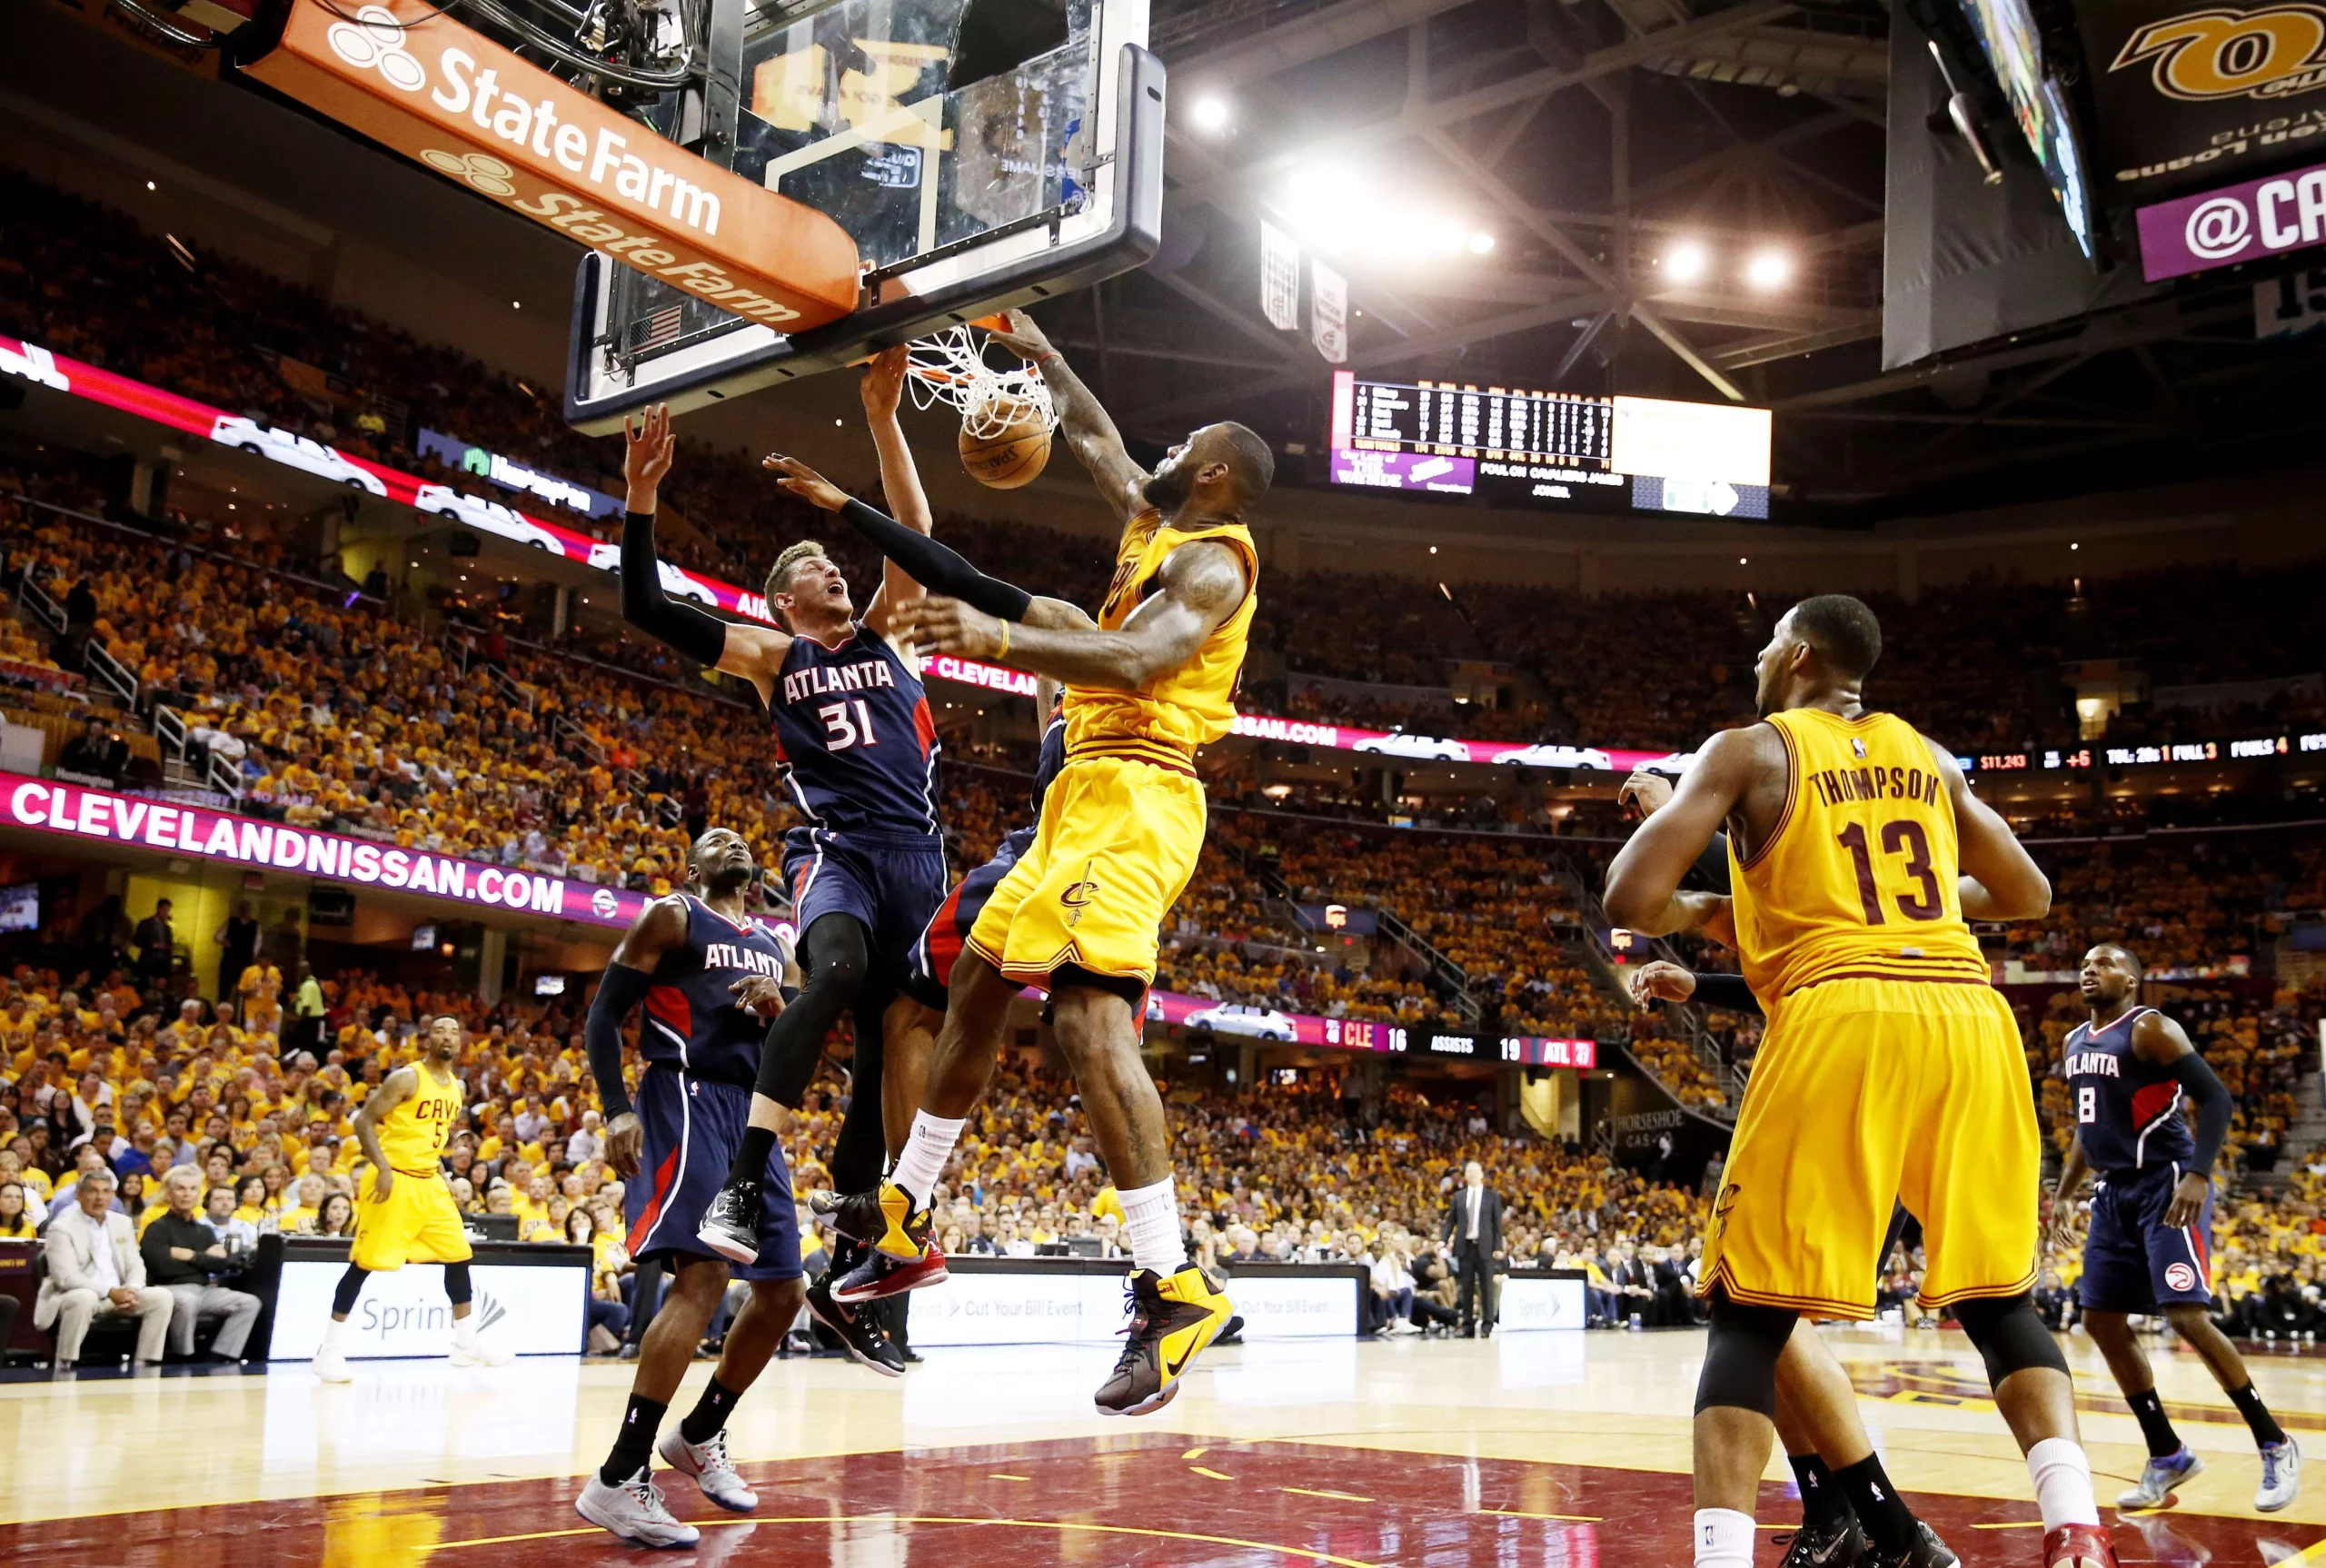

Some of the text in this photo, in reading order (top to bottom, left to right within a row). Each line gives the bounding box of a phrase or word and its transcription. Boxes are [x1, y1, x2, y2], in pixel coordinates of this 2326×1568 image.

[2114, 140, 2248, 182] Loans
[1480, 462, 1509, 477] FOUL
[1509, 465, 1527, 478] ON
[1529, 467, 1587, 483] CAVALIERS
[783, 660, 896, 706] ATLANTA
[818, 700, 879, 753] 31
[2065, 749, 2092, 769] +6
[2172, 743, 2206, 761] FULL
[2205, 741, 2219, 761] 3
[2230, 738, 2275, 759] FOULS
[2275, 736, 2290, 755] 4
[1808, 766, 1940, 809] THOMPSON
[11, 782, 565, 915] CLEVELANDNISSAN.COM
[1836, 819, 1944, 927] 13
[1344, 1021, 1374, 1048] CLE
[1387, 1027, 1407, 1052] 16
[1430, 1034, 1474, 1055] ASSISTS
[1500, 1037, 1521, 1061] 19
[1544, 1041, 1571, 1065] ATL
[1617, 1109, 1685, 1132] HORSESHOE
[2078, 1087, 2097, 1124] 8
[432, 1121, 444, 1149] 5
[1625, 1131, 1673, 1148] CASO
[910, 1299, 1082, 1318] print Cut Your Bill Event
